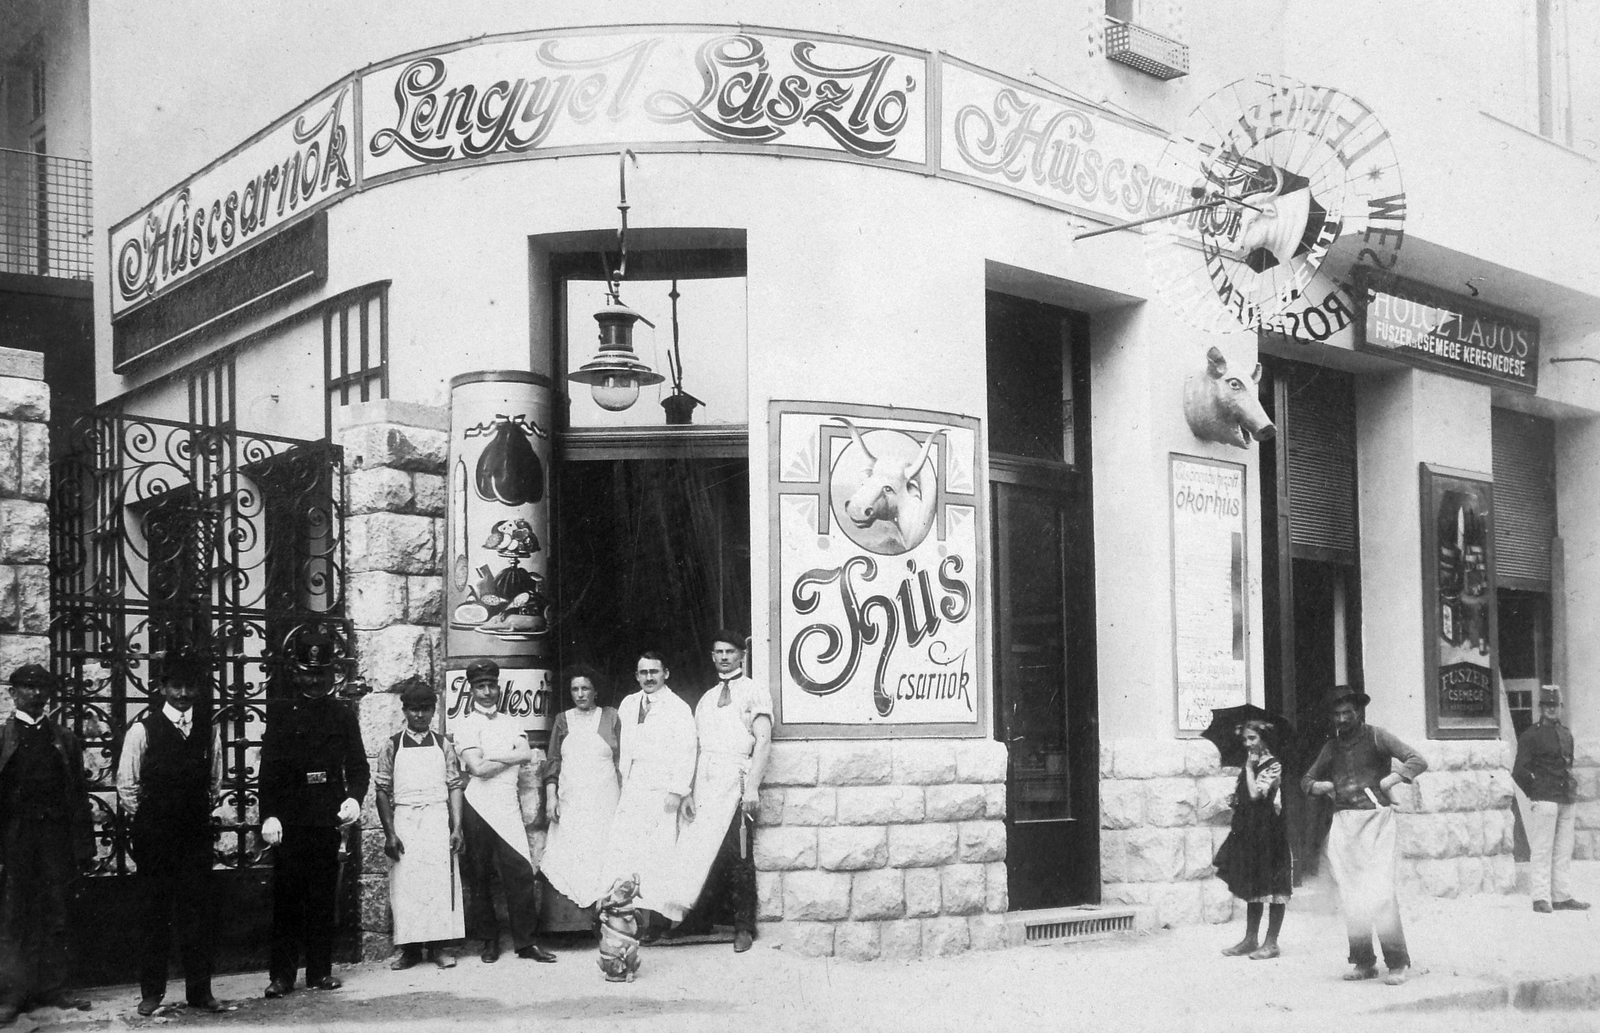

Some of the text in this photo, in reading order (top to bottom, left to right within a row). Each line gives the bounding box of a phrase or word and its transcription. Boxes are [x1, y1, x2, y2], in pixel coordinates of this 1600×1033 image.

[369, 35, 916, 163] Lengyel László
[118, 86, 351, 301] Húscsarnok
[1457, 313, 1529, 358] LAJOS
[788, 555, 972, 718] Hús
[896, 641, 973, 712] csarnok
